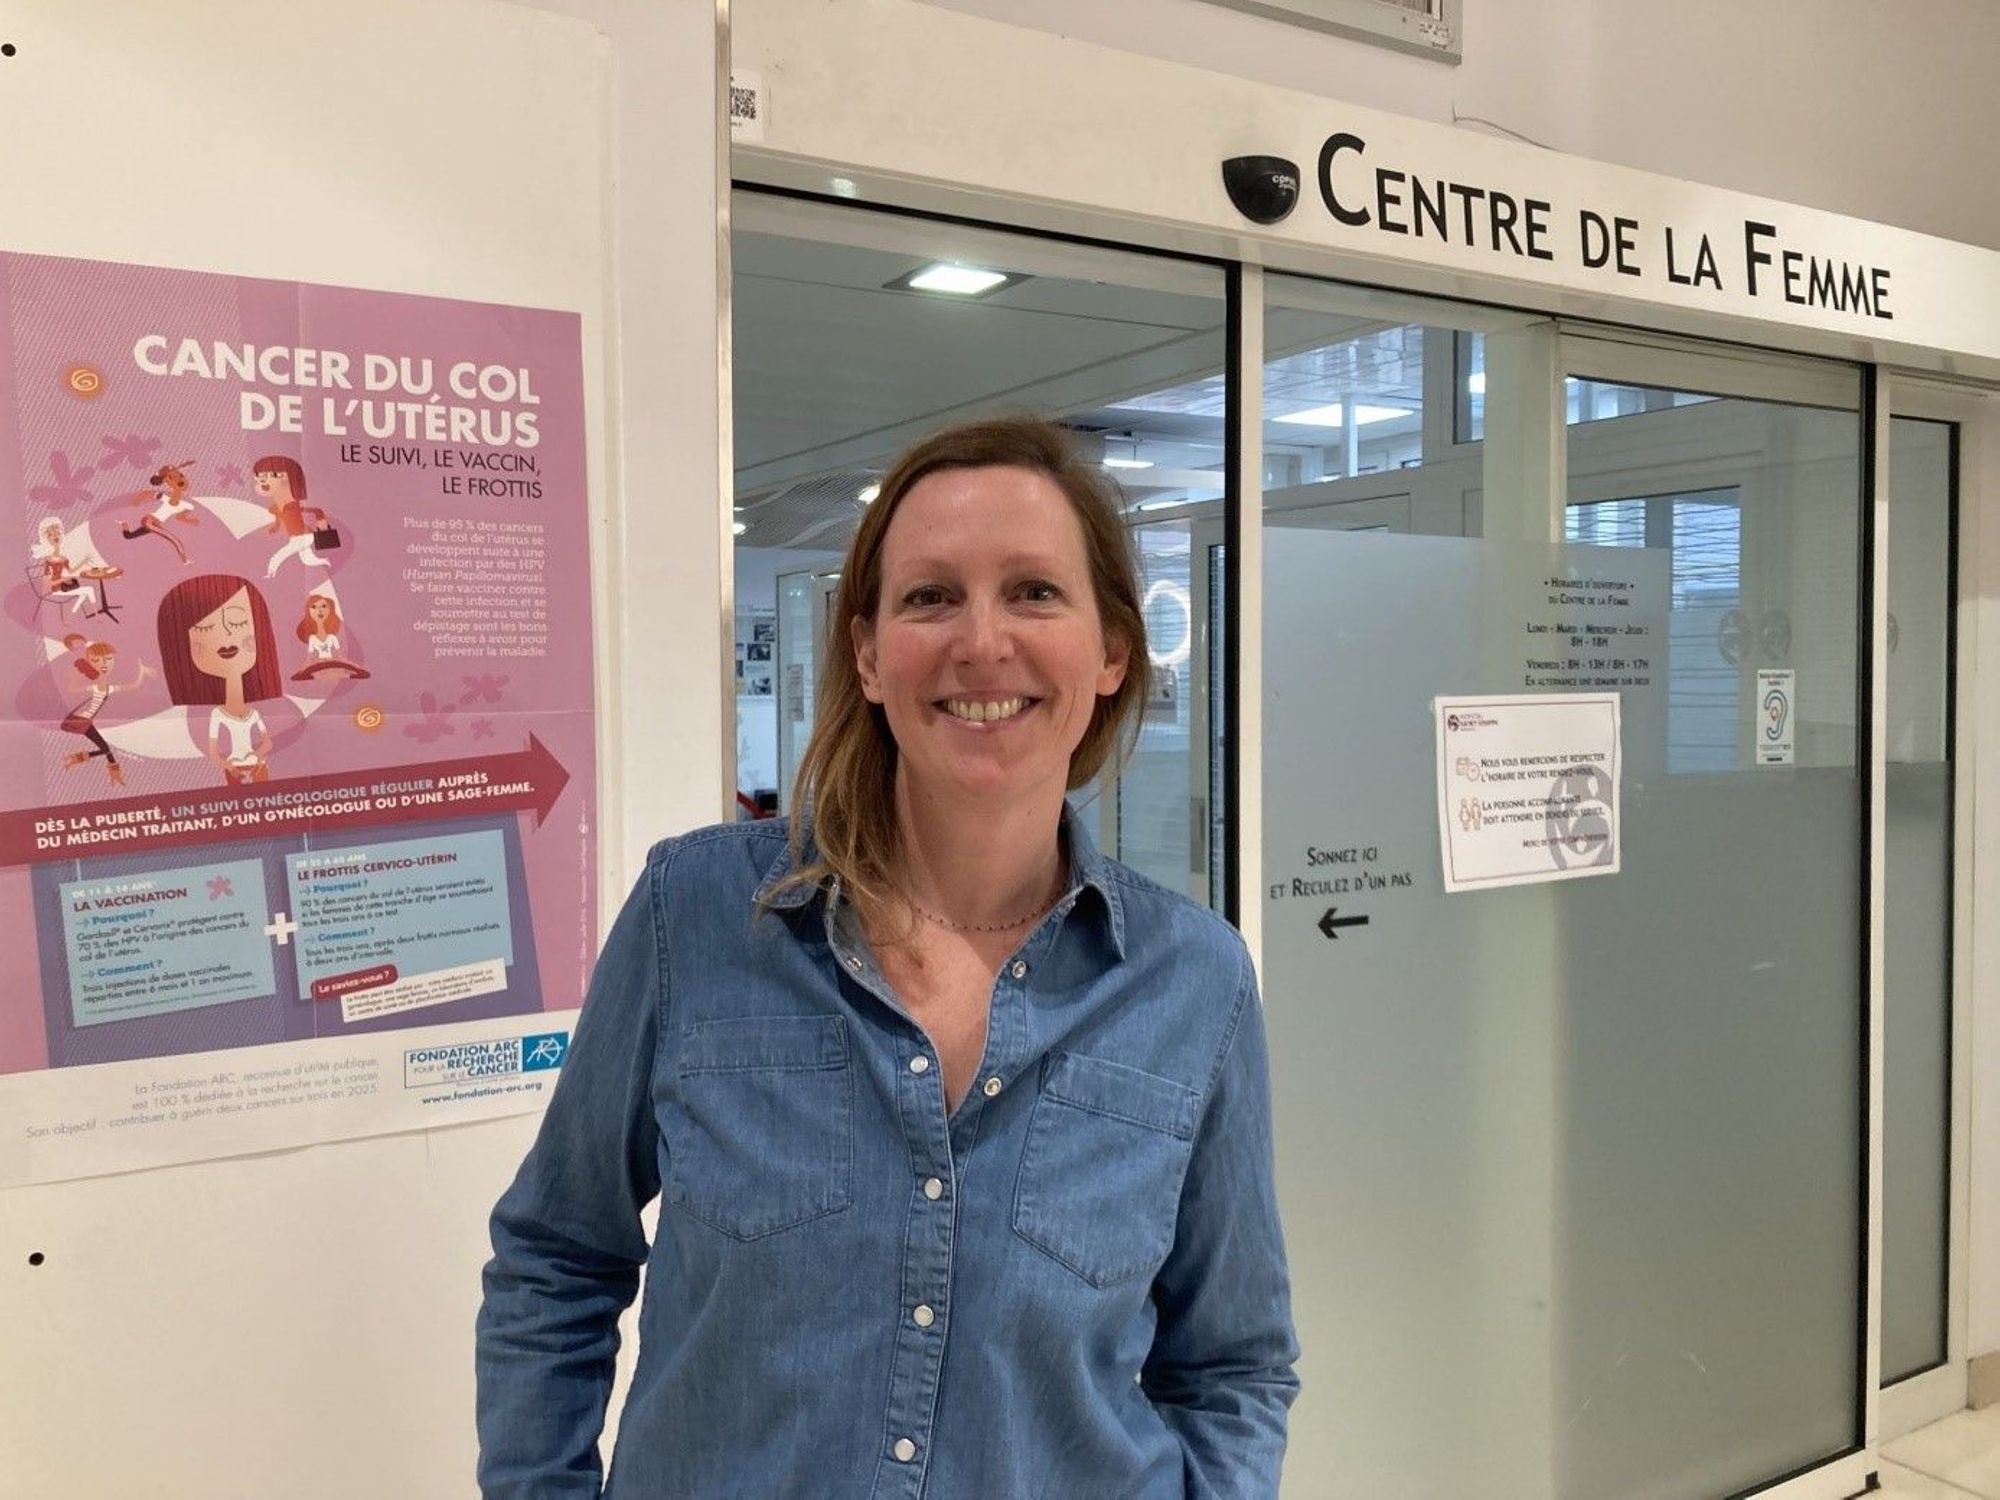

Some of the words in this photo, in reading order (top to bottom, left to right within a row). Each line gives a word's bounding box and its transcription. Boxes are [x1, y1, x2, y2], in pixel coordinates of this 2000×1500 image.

[1317, 132, 1553, 262] CENTRE
[1580, 210, 1640, 276] DE
[1665, 227, 1722, 290] LA
[1744, 220, 1893, 320] FEMME
[134, 334, 352, 390] CANCER
[364, 353, 433, 395] DU
[449, 360, 540, 405] COL
[240, 391, 303, 432] DE
[323, 392, 540, 448] L'UTÉRUS
[340, 444, 361, 464] LE
[369, 445, 427, 470] SUIVI,
[434, 450, 453, 468] LE
[459, 451, 541, 476] VACCIN,
[442, 476, 461, 496] LE
[467, 478, 543, 499] FROTTIS
[403, 516, 429, 528] Plus
[432, 518, 446, 530] de
[477, 520, 496, 532] des
[500, 523, 544, 533] cancers
[432, 531, 448, 542] du
[450, 532, 467, 542] col
[471, 533, 484, 544] de
[532, 538, 544, 546] se
[407, 544, 480, 558] développent
[522, 550, 544, 558] une
[402, 569, 451, 580] (Human
[420, 557, 472, 568] infection
[476, 560, 494, 570] par
[497, 558, 516, 570] des
[410, 582, 424, 592] Se
[428, 582, 454, 593] faire
[457, 584, 506, 594] vacciner
[510, 585, 546, 595] contre
[466, 596, 518, 606] infection
[430, 608, 490, 618] soumettre
[532, 608, 546, 619] de
[35, 817, 66, 834] DÈS
[71, 816, 91, 830] LA
[96, 806, 168, 827] PUBERTÉ,
[172, 804, 195, 818] UN
[200, 800, 240, 814] SUIVI
[244, 786, 368, 810] GYNÉCOLOGIQUE
[371, 778, 434, 796] RÉGULIER
[438, 771, 489, 788] AUPRÈS
[1482, 800, 1492, 812] LA
[37, 836, 61, 850] DU
[67, 824, 138, 846] MÉDECIN
[142, 819, 218, 838] TRAITANT,
[222, 812, 260, 828] D'UN
[265, 801, 371, 823] GYNÉCOLOGUE
[376, 796, 397, 809] OU
[402, 791, 443, 806] D'UNE
[448, 781, 534, 801] SAGE-FEMME.
[298, 870, 310, 880] LE
[313, 865, 360, 879] FROTTIS
[364, 853, 458, 873] CERVICO-UTÉRIN
[1307, 846, 1357, 867] SONNEZ
[1362, 847, 1378, 862] ICI
[1270, 884, 1286, 900] ET
[1292, 877, 1350, 897] RECULEZ
[1355, 871, 1386, 891] D'UN
[1391, 872, 1412, 887] PAS
[74, 902, 91, 912] LA
[94, 888, 188, 908] VACCINATION
[92, 910, 147, 926] Pourquoi
[150, 908, 156, 918] ?
[98, 961, 154, 978] Comment
[156, 960, 164, 969] ?
[318, 985, 330, 994] Le
[384, 970, 390, 979] ?
[410, 1043, 490, 1064] FONDATION
[495, 1040, 519, 1054] ARC
[414, 1066, 434, 1075] POUR
[447, 1052, 518, 1070] RECHERCHE
[468, 1062, 518, 1077] CANCER
[136, 1084, 148, 1095] La
[422, 1082, 542, 1105] www.fondation-arc.org
